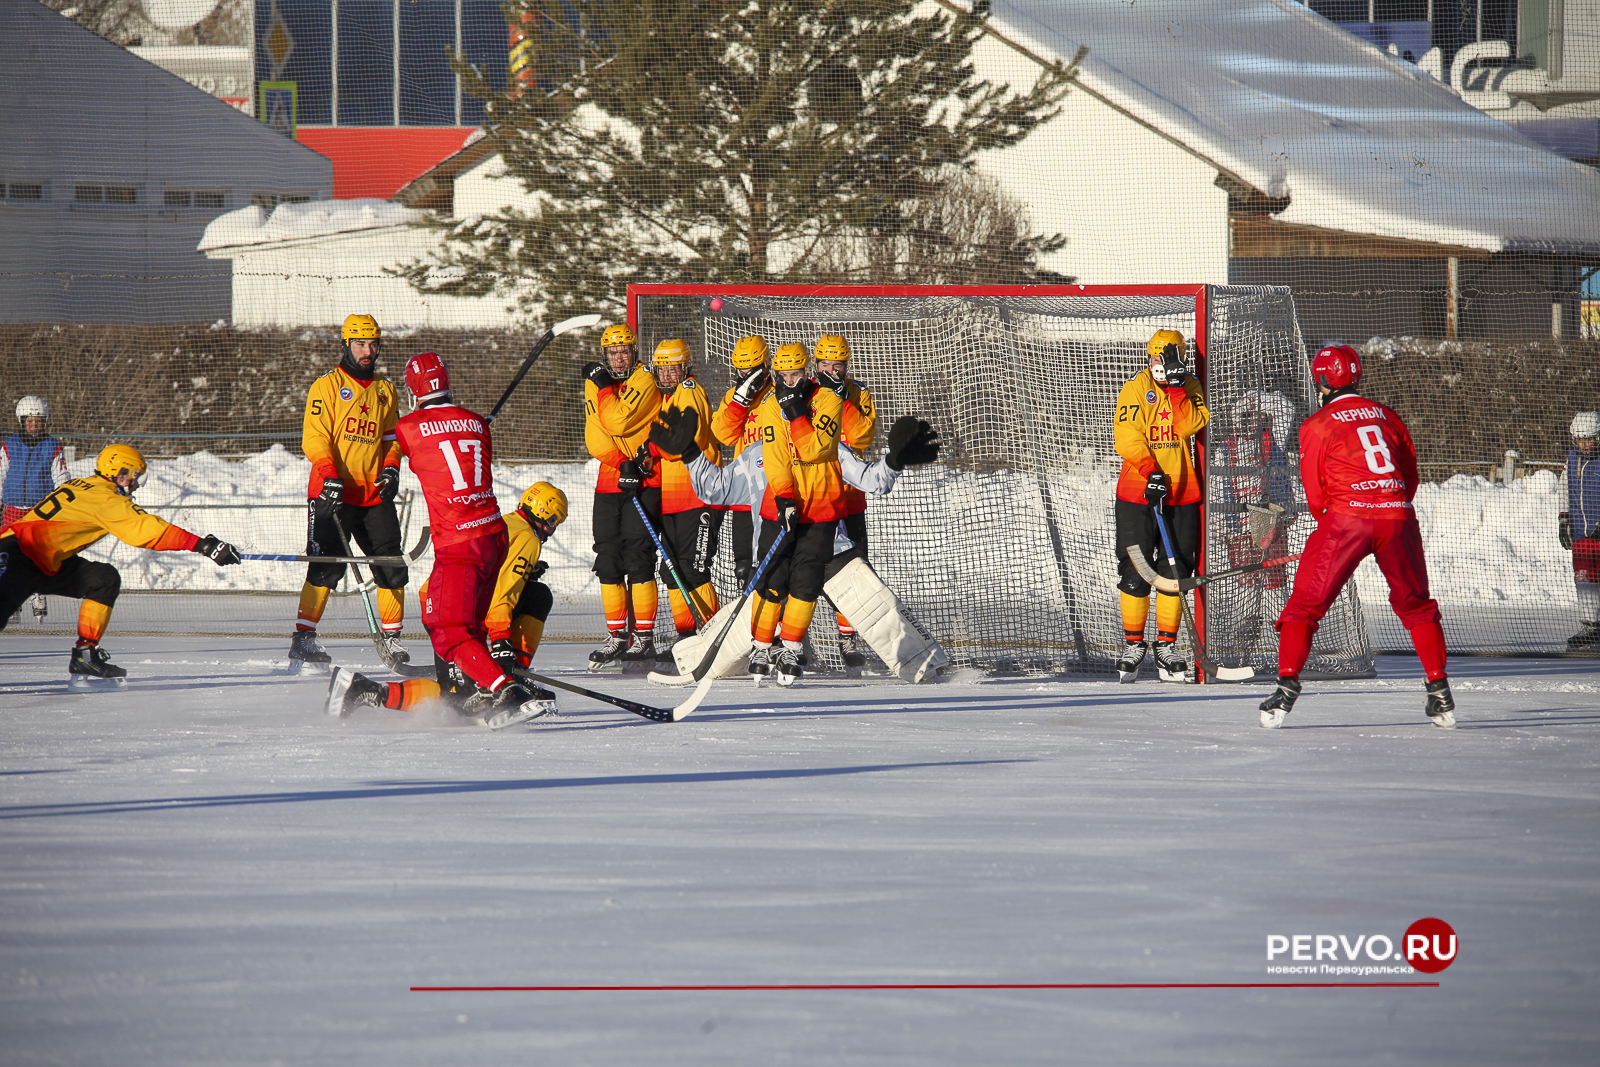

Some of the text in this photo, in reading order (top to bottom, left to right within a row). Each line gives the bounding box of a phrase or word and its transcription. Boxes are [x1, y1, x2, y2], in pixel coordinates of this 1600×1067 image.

[1350, 362, 1357, 374] 8
[429, 377, 439, 391] 17
[623, 387, 641, 405] 11
[311, 399, 323, 416] 5
[585, 399, 597, 416] 11
[1119, 404, 1140, 423] 27
[1331, 406, 1387, 423] ЧЕРНЫХ
[345, 416, 378, 438] СКА
[419, 418, 484, 438] ВШИВКОВ
[816, 414, 839, 438] 99
[1356, 424, 1396, 475] 8
[438, 439, 483, 491] 17
[900, 608, 931, 642] BAUER
